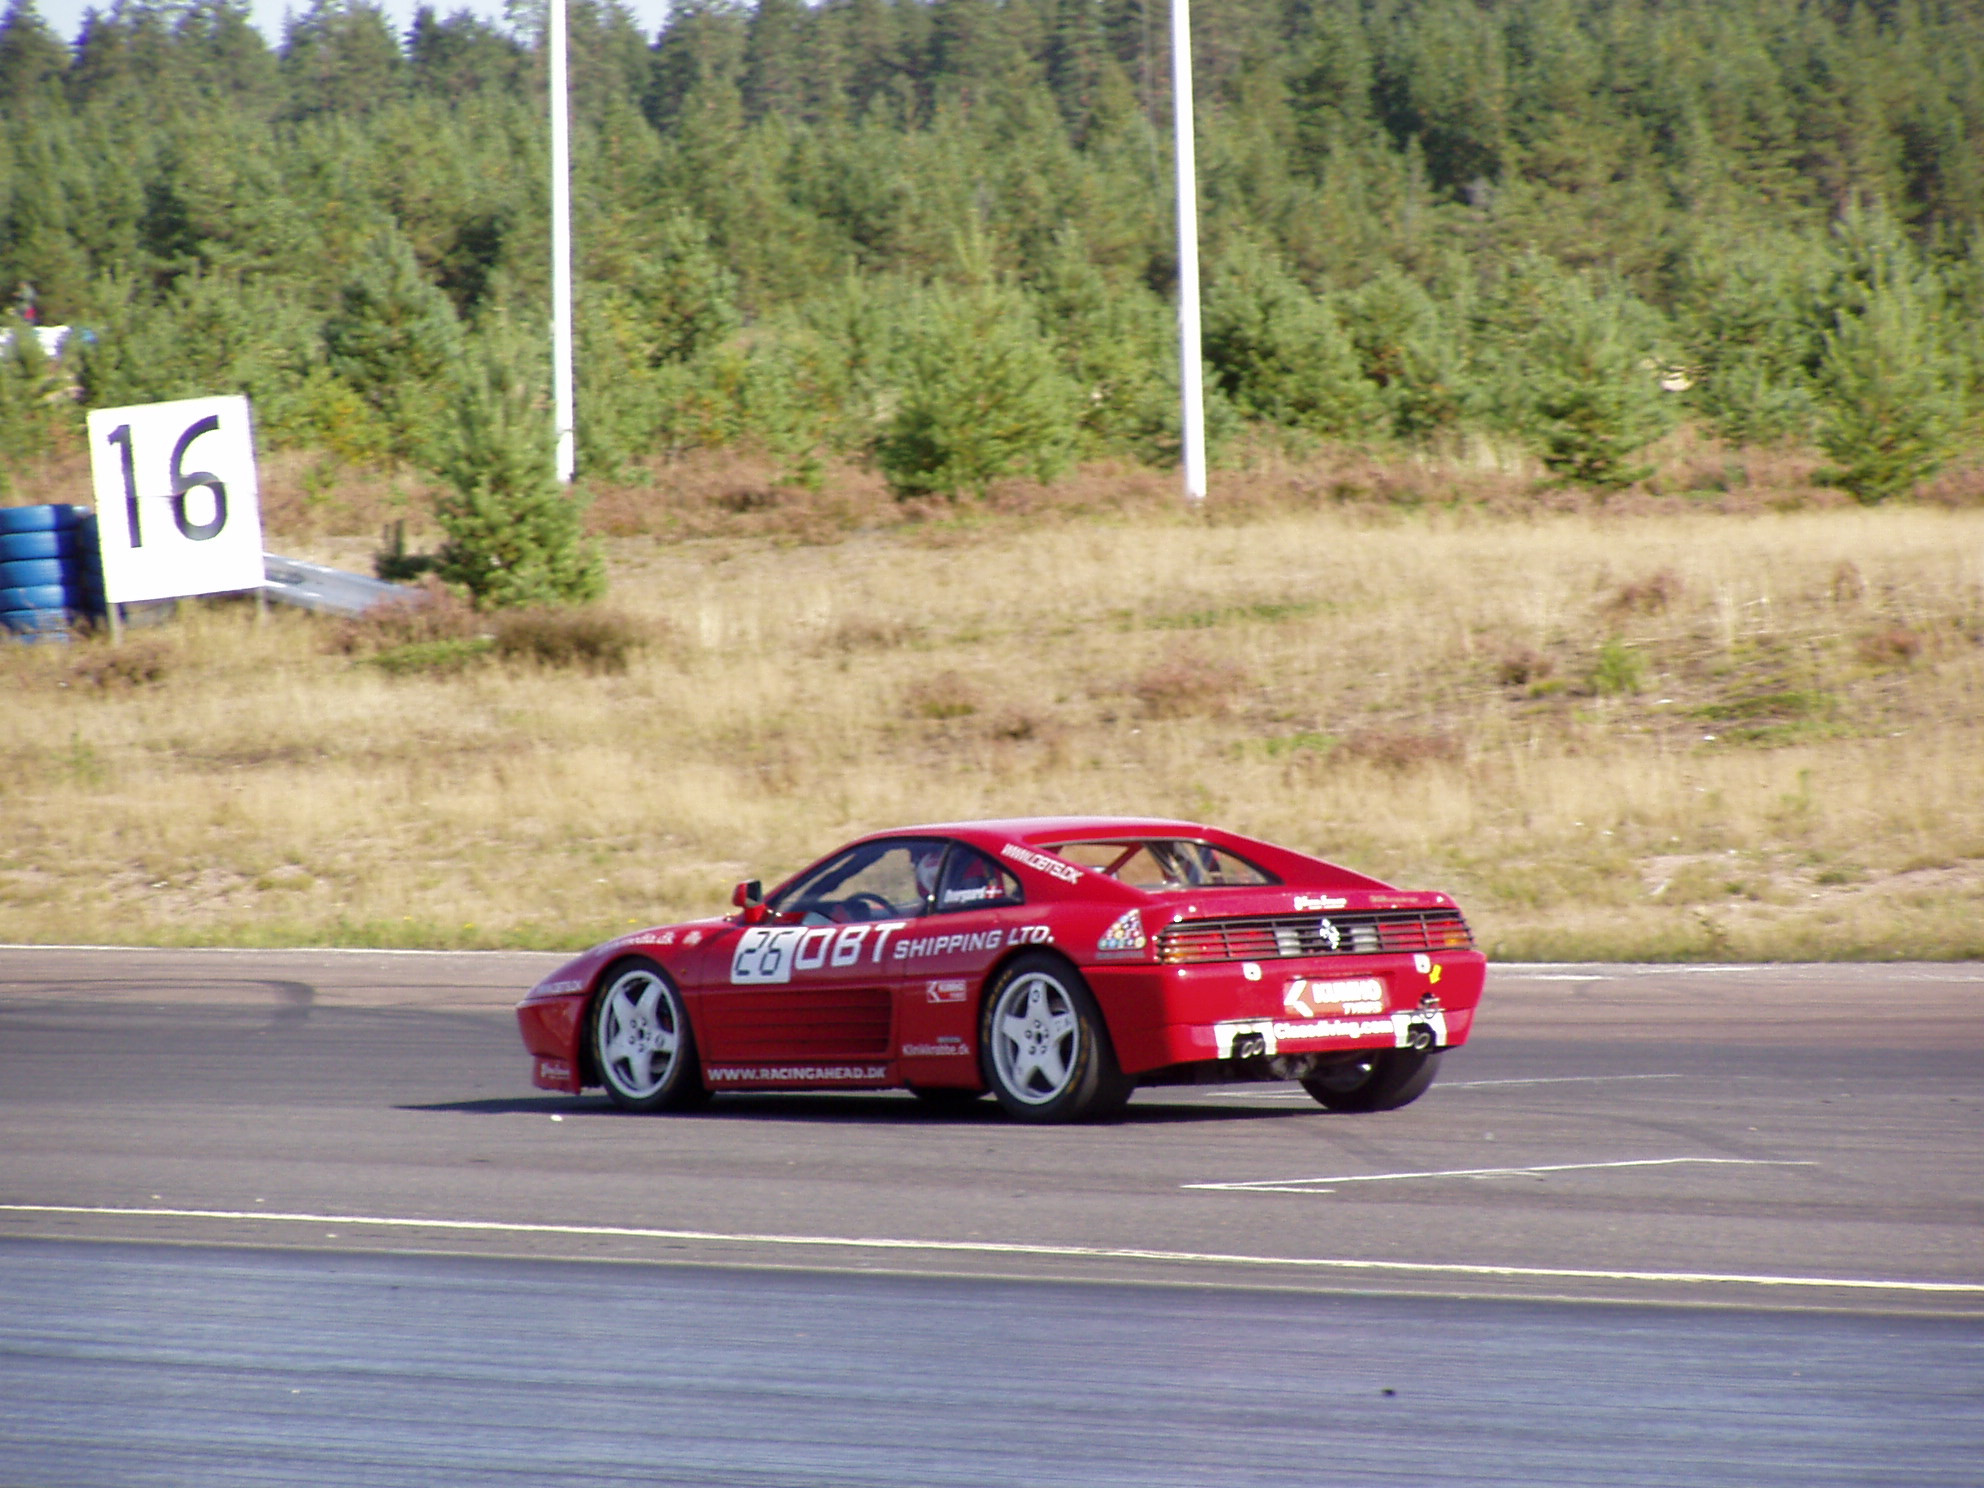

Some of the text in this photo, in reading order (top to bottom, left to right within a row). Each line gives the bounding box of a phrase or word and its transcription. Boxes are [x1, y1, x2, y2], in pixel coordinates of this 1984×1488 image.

[107, 414, 228, 549] 16
[734, 930, 794, 977] 26
[795, 922, 1056, 971] OBT SHIPPING LTD.
[707, 1066, 887, 1081] WWW.RACINGAHEAD.DK
